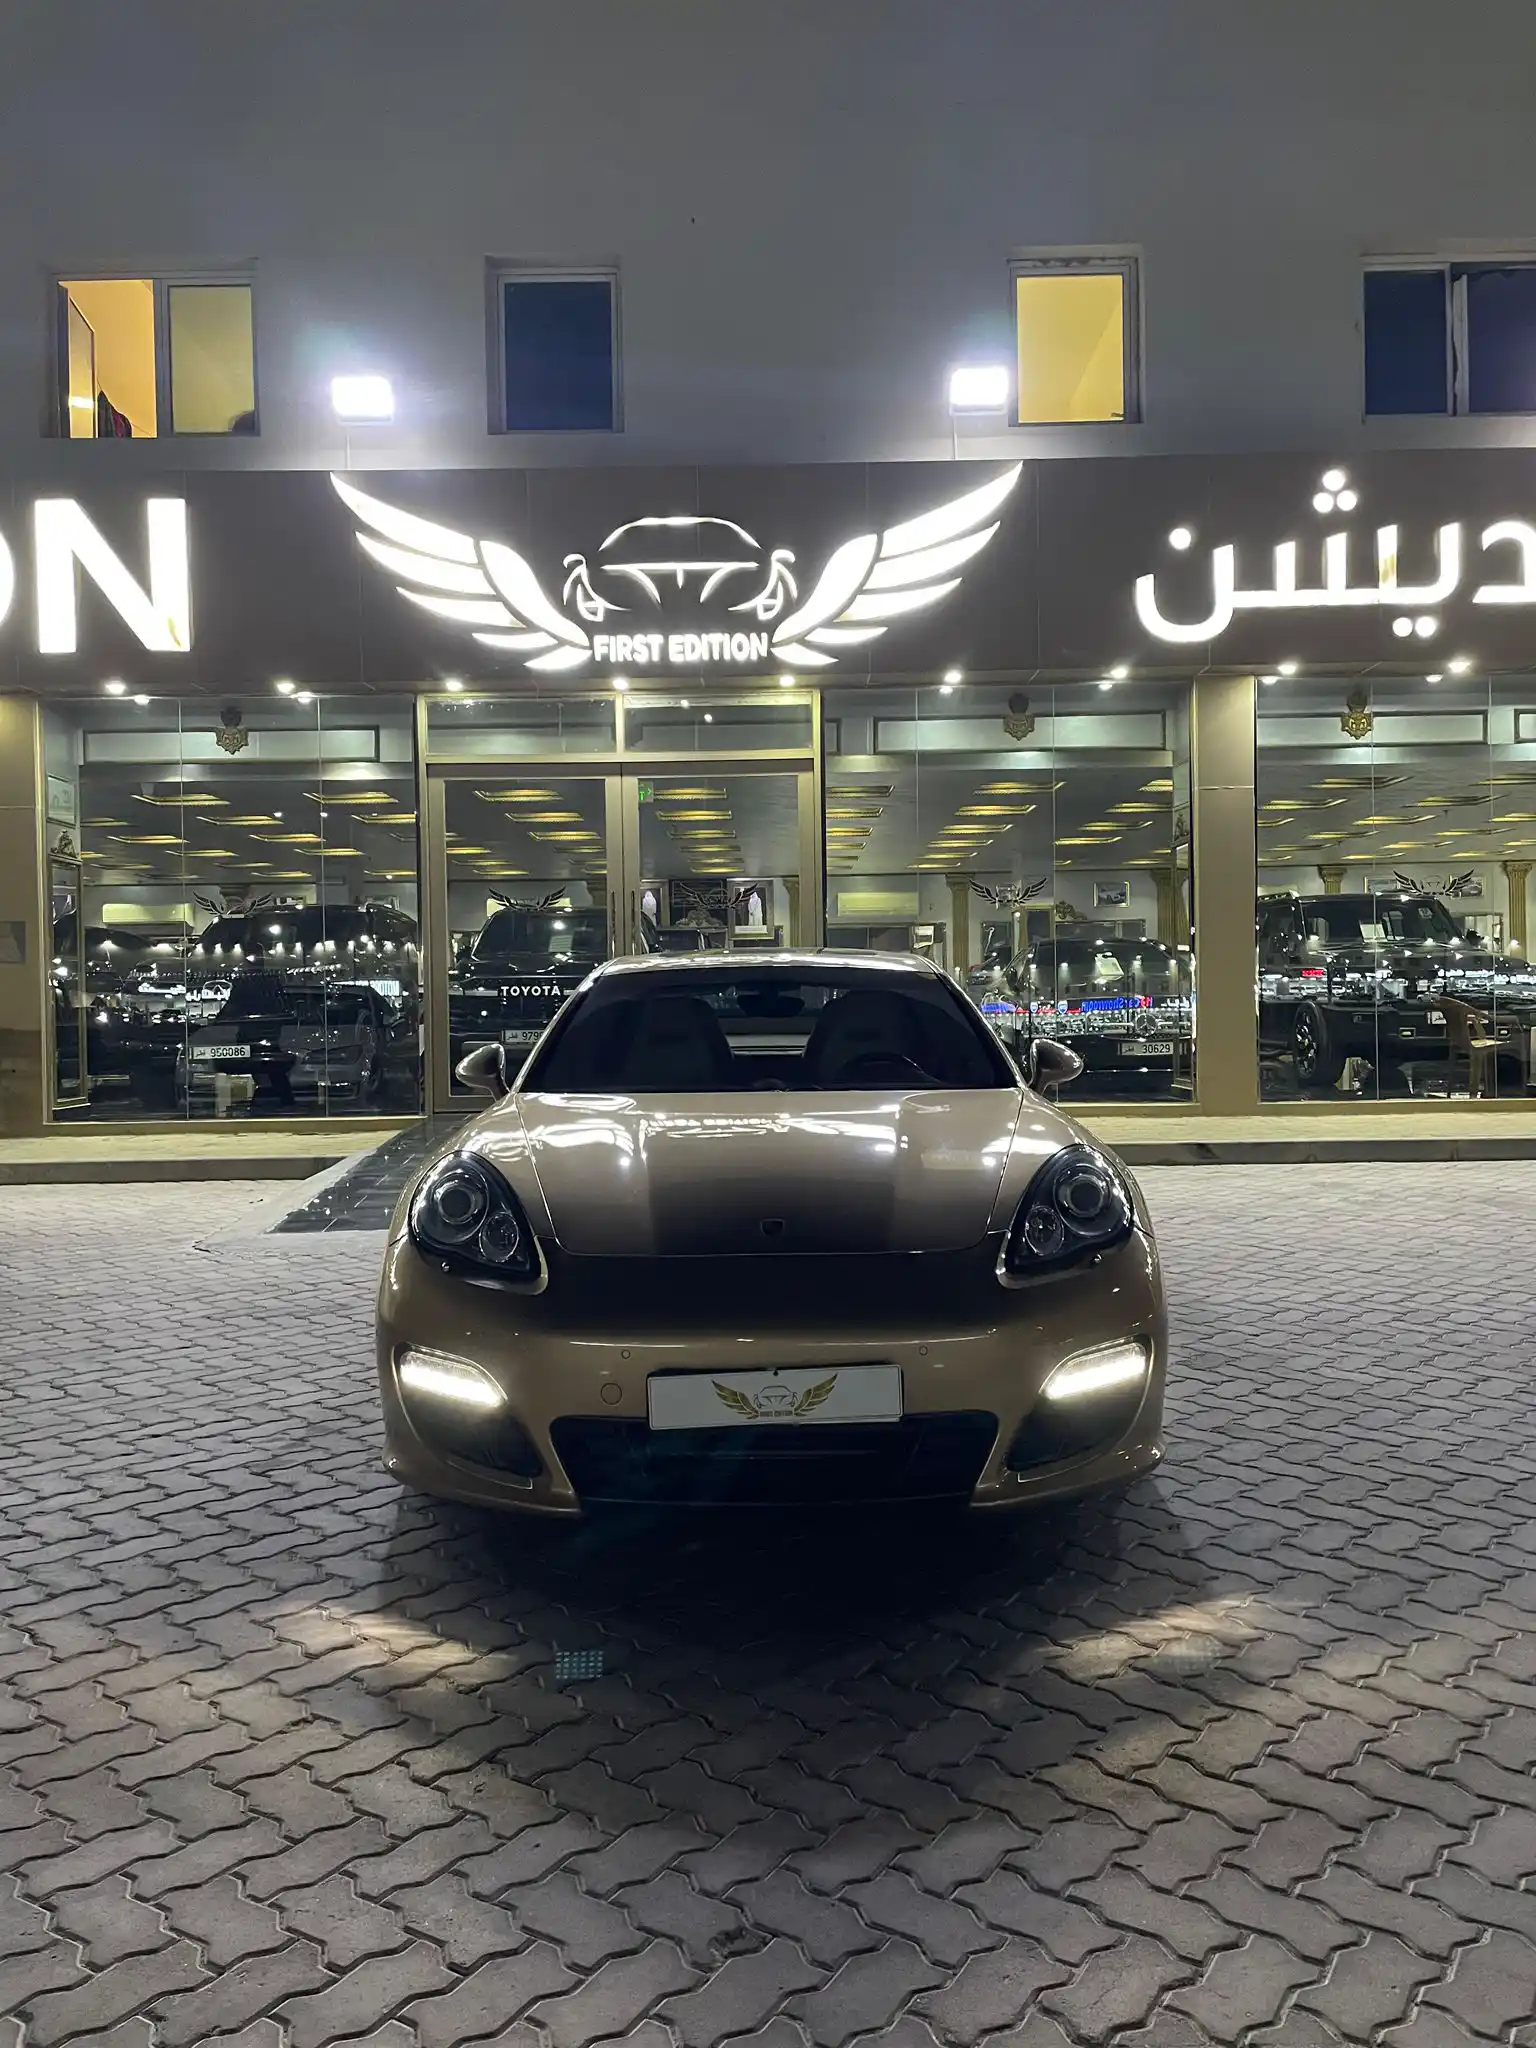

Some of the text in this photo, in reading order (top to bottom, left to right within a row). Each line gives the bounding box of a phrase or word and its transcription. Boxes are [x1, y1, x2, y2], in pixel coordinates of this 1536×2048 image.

[0, 498, 193, 653] N
[593, 631, 768, 663] FIRST EDITION
[500, 985, 561, 997] TOYOTA
[521, 1031, 544, 1041] 979
[210, 1046, 246, 1058] 950086
[1142, 1043, 1171, 1054] 30629
